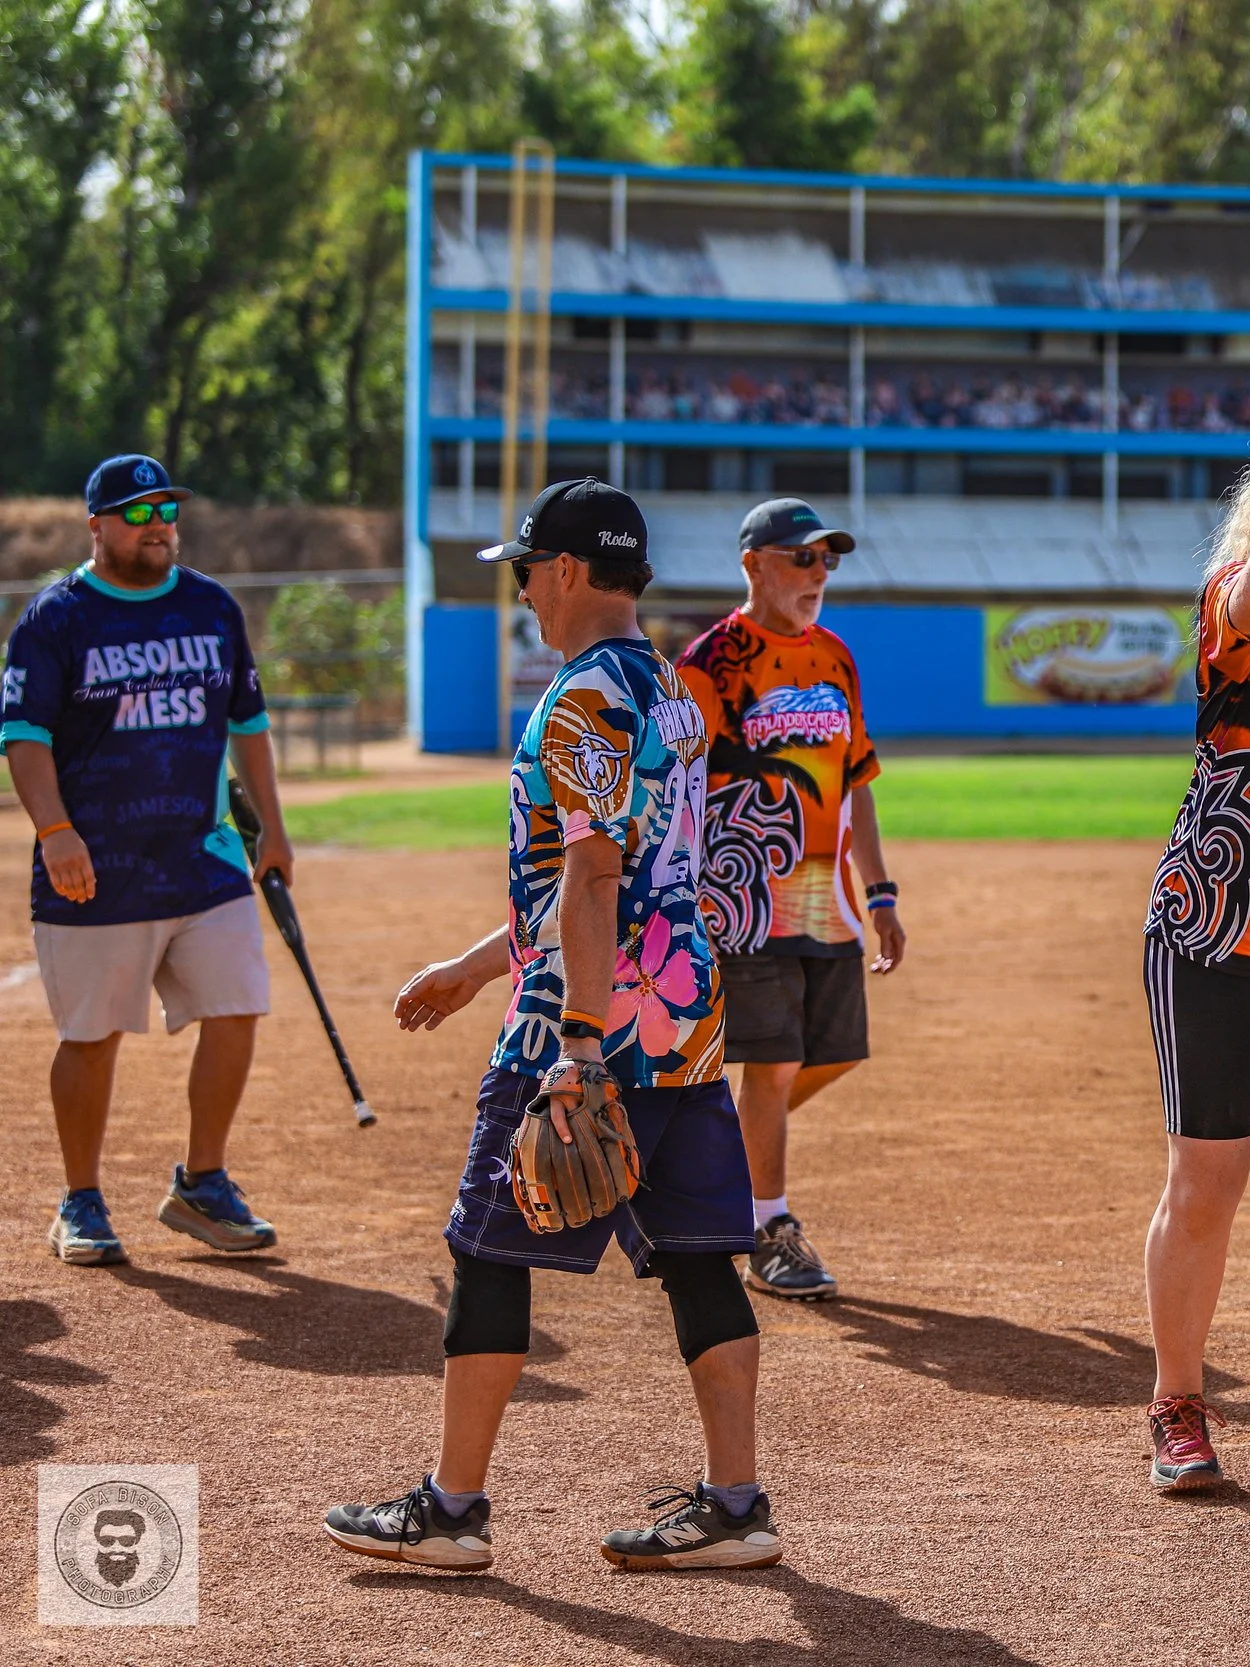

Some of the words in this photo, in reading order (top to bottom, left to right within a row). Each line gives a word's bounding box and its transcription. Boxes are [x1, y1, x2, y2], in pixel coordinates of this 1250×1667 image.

[599, 531, 638, 548] Rodeo
[83, 635, 223, 686] ABSOLUT
[113, 686, 207, 731] MESS
[744, 710, 846, 750] THUNDERCATS
